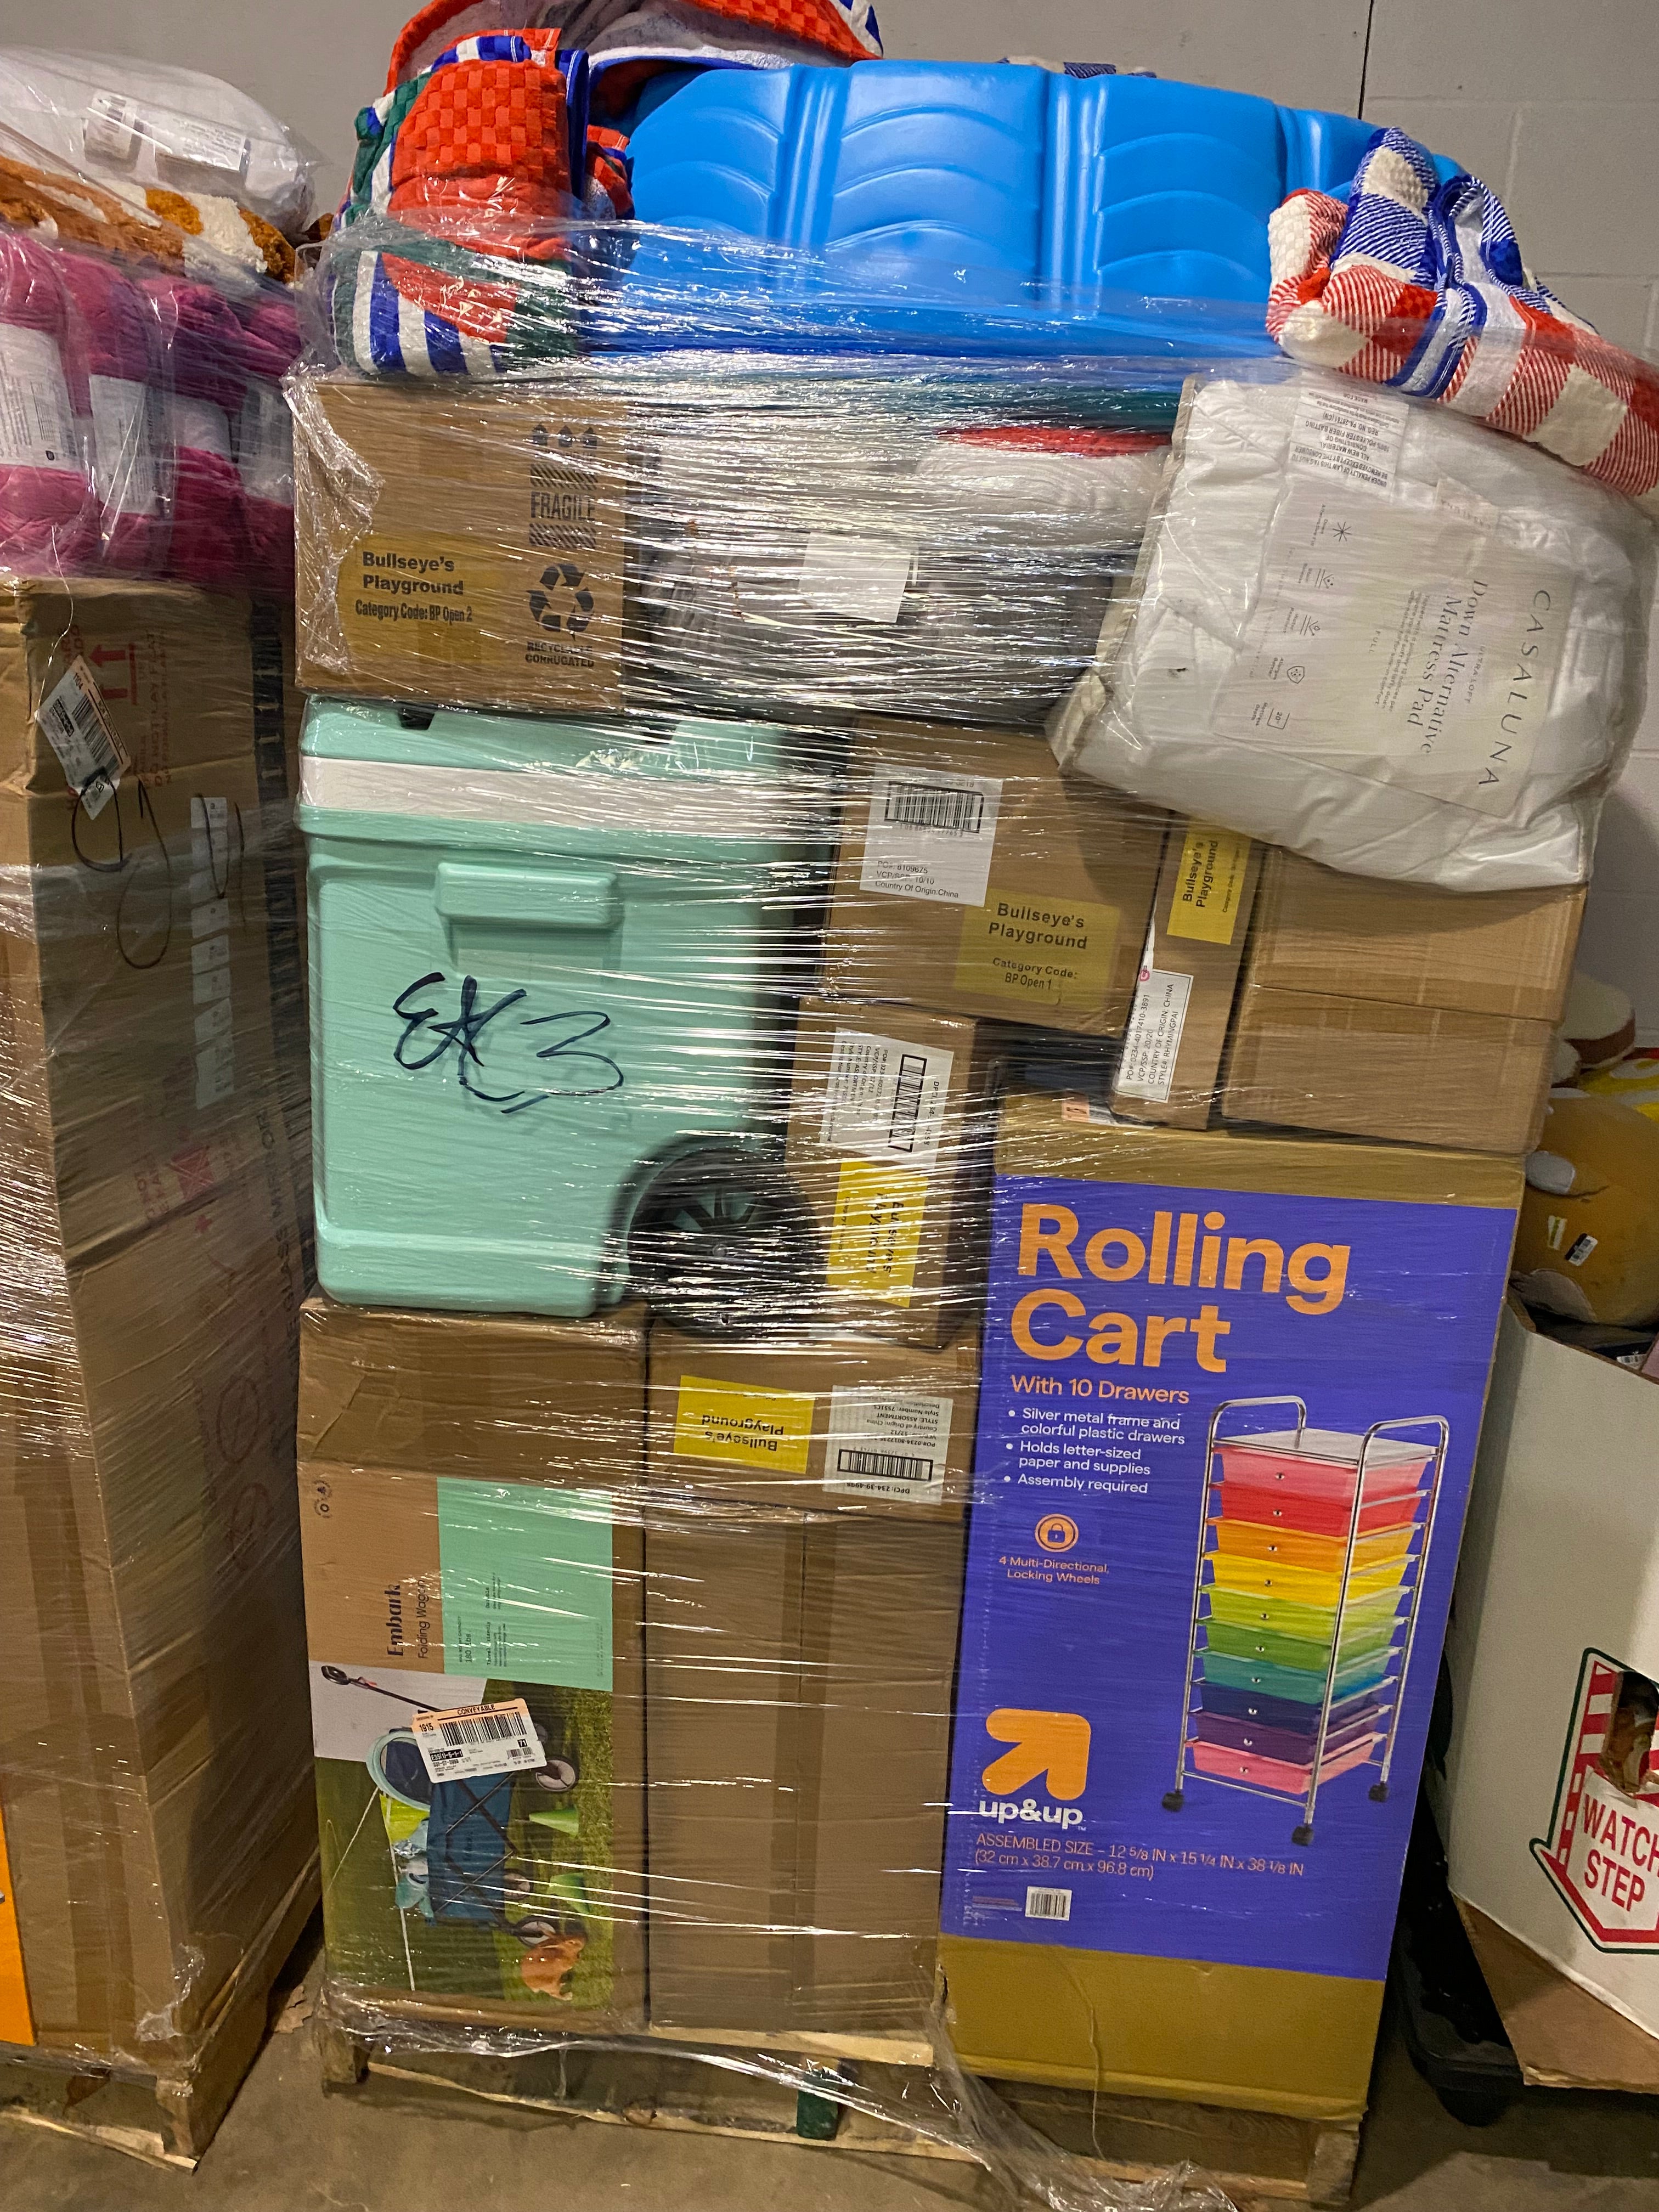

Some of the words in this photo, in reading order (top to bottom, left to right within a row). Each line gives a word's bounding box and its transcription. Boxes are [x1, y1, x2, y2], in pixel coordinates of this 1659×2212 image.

[1305, 420, 1329, 432] BATTING
[1328, 427, 1345, 437] FIBER
[1319, 442, 1347, 453] MATERIAL
[1346, 432, 1376, 447] POLYESTER
[1347, 448, 1359, 456] NEW
[1360, 452, 1370, 460] ALL
[1350, 469, 1371, 481] PENALTY
[531, 492, 595, 521] FRAGILE
[363, 552, 454, 573] Bullseye's
[363, 575, 464, 595] Playground
[356, 600, 398, 621] Category
[400, 602, 427, 620] Code:
[429, 605, 440, 620] BP
[443, 607, 464, 625] Open
[466, 609, 472, 622] 2
[1460, 580, 1488, 636] Down
[1368, 630, 1381, 655] FULL
[1423, 596, 1462, 680] Mattress
[1421, 647, 1469, 754] Alternative
[1478, 590, 1551, 786] CASALUNA
[1407, 688, 1434, 726] Pad
[915, 875, 935, 885] 10/10
[1182, 841, 1204, 903] Bullseye's
[1195, 839, 1219, 909] Playground
[875, 879, 903, 891] Country
[997, 902, 1085, 928] Bullseye's
[989, 922, 1088, 950] Playground
[992, 957, 1042, 976] Category
[1045, 964, 1077, 980] Code:
[1163, 983, 1174, 1008] CHINA
[1157, 1009, 1169, 1037] ORIGIN:
[1163, 1011, 1178, 1057] RHYMINGPAI
[1155, 1038, 1163, 1048] OF
[1148, 1049, 1160, 1085] COUNTRY
[1018, 1203, 1351, 1315] Rolling
[1011, 1289, 1231, 1373] Cart
[1011, 1375, 1063, 1396] With
[1070, 1378, 1093, 1398] 10
[1099, 1381, 1189, 1404] Drawers
[702, 1414, 784, 1436] Playground
[876, 1412, 917, 1422] ASSORTMENT
[884, 1420, 905, 1428] Origin:
[913, 1424, 937, 1432] Country
[1023, 1407, 1061, 1423] Silver
[1064, 1410, 1104, 1424] metal
[1108, 1413, 1149, 1427] frame
[1153, 1416, 1180, 1430] and
[1021, 1422, 1076, 1438] colorful
[1079, 1425, 1125, 1443] plastic
[1128, 1430, 1185, 1444] drawers
[1020, 1441, 1059, 1455] Holds
[1063, 1442, 1141, 1460] letter-sized
[1019, 1458, 1059, 1473] paper
[1064, 1458, 1090, 1471] and
[1093, 1462, 1150, 1476] supplies
[1018, 1474, 1084, 1491] Assembly
[1088, 1478, 1148, 1493] required
[999, 1556, 1006, 1565] 4
[1007, 1568, 1053, 1583] Locking
[1057, 1571, 1100, 1584] Wheels
[418, 1579, 430, 1618] Wagon
[386, 1583, 403, 1656] Embark
[418, 1619, 431, 1659] Folding
[457, 1704, 495, 1716] CONVEYABLE
[419, 1723, 435, 1734] 1915
[979, 1799, 1083, 1830] up&up
[1584, 1793, 1659, 1877] WATCH
[974, 1848, 994, 1866] (32
[999, 1854, 1018, 1865] cm
[1021, 1857, 1029, 1866] x
[1031, 1854, 1060, 1870] 38.7
[1064, 1860, 1085, 1871] cm
[1097, 1860, 1126, 1876] 96.8
[1130, 1864, 1154, 1881] cm)
[977, 1833, 1060, 1853] ASSEMBLED
[1065, 1841, 1093, 1856] SIZE
[1109, 1844, 1125, 1858] 12
[1152, 1849, 1166, 1861] IN
[1169, 1853, 1177, 1863] x
[1181, 1850, 1197, 1864] 15
[1220, 1855, 1234, 1869] IN
[1237, 1859, 1244, 1869] x
[1248, 1858, 1266, 1872] 38
[1289, 1863, 1304, 1876] IN
[1584, 1849, 1645, 1911] STEP
